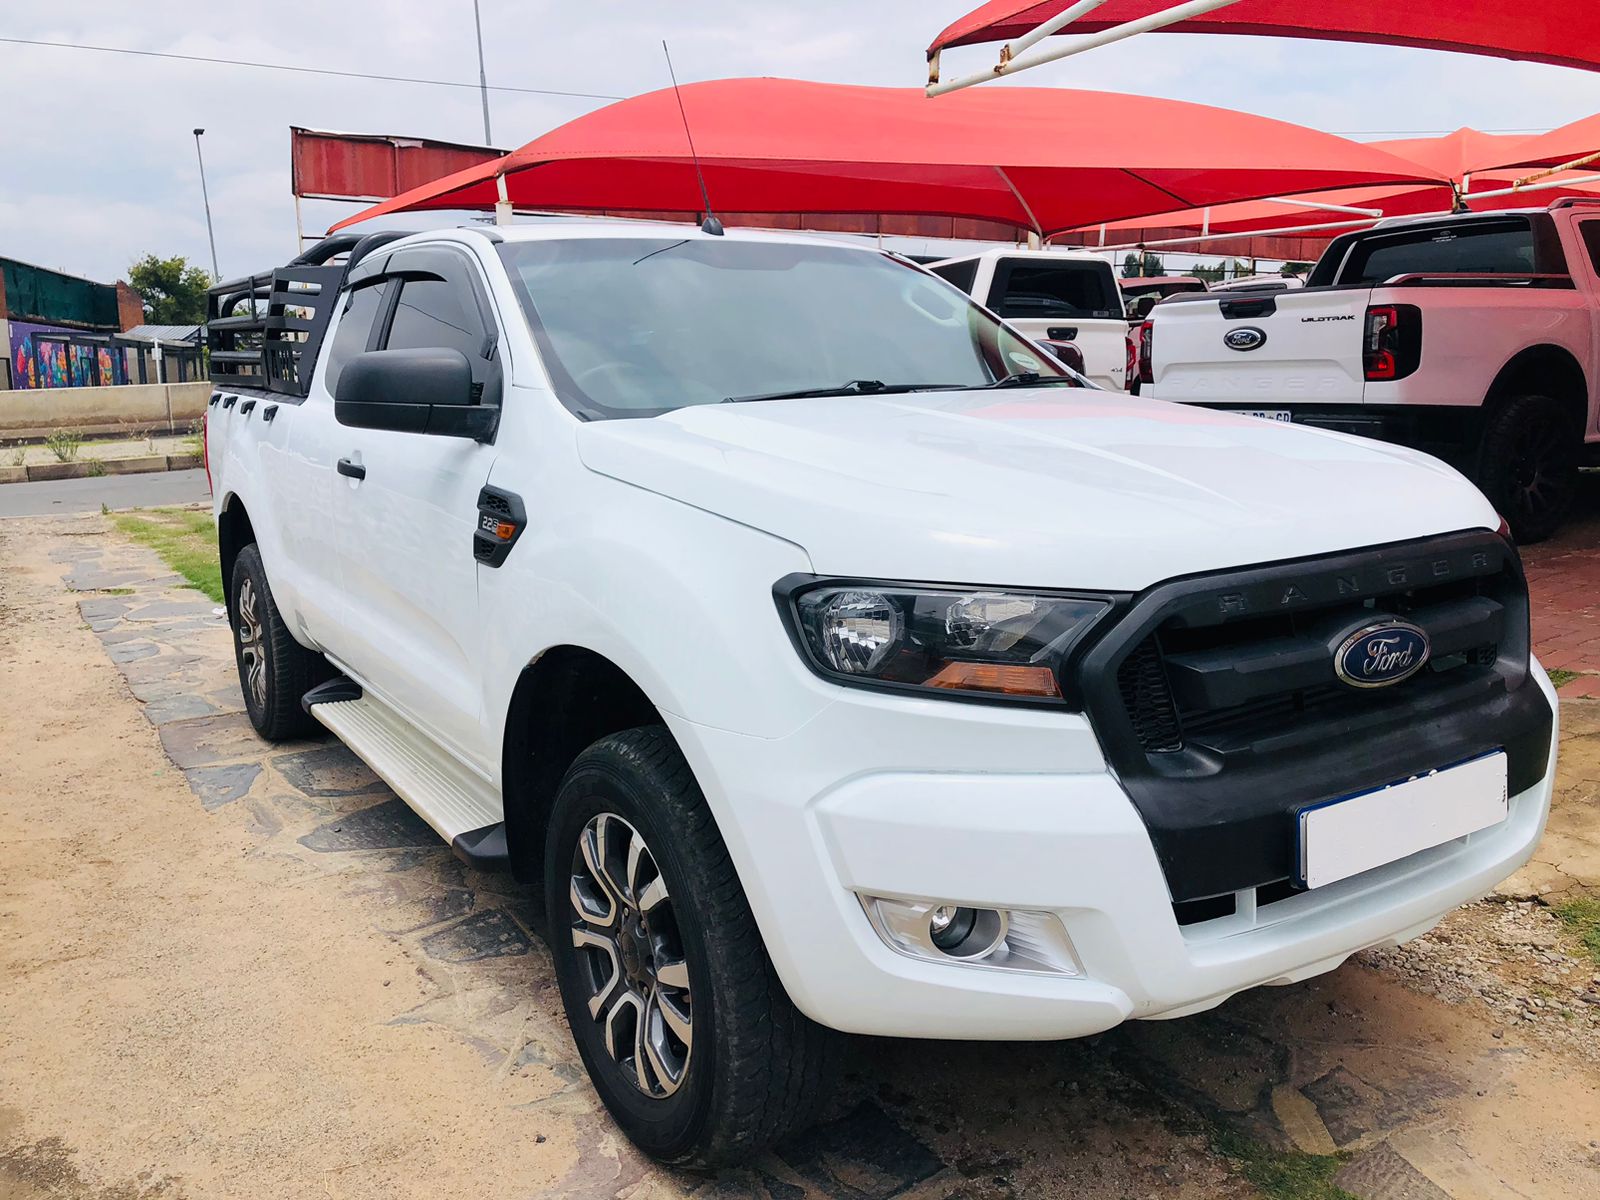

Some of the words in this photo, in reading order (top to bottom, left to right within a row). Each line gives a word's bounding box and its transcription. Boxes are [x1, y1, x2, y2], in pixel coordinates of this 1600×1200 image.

[1301, 315, 1356, 323] WILDTRAK
[1231, 332, 1252, 344] Ford
[1219, 553, 1487, 613] RANGER
[1363, 637, 1414, 676] Ford
